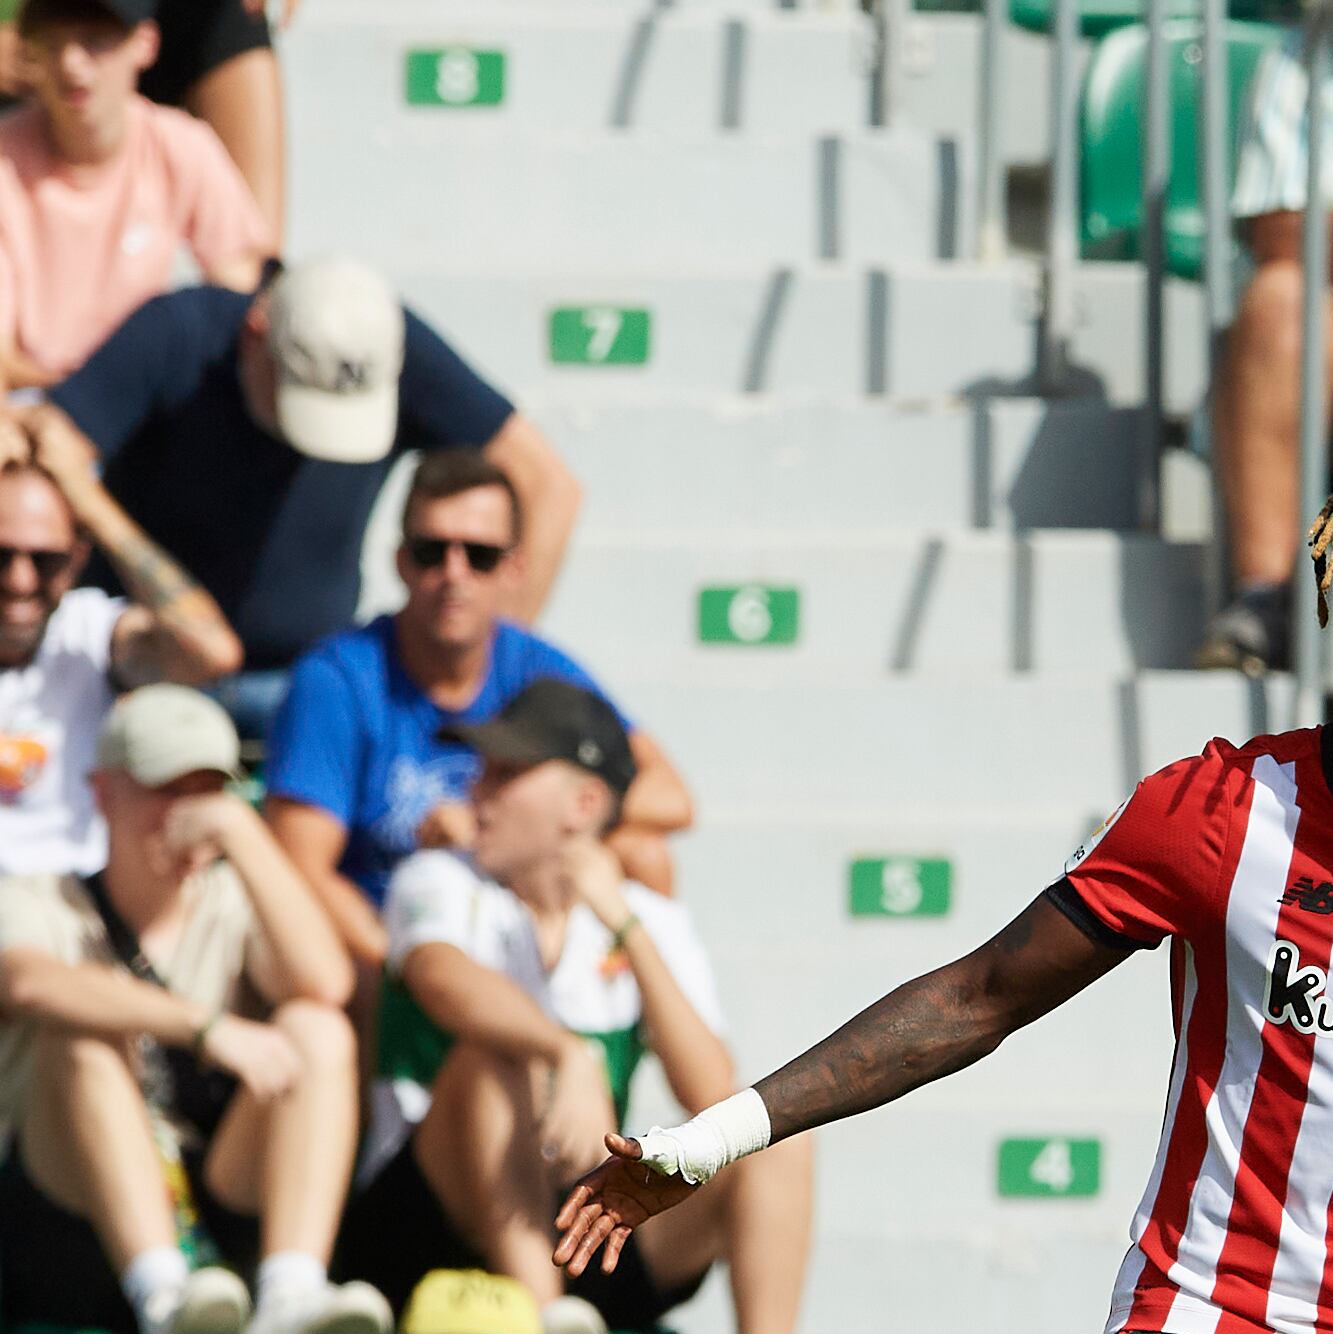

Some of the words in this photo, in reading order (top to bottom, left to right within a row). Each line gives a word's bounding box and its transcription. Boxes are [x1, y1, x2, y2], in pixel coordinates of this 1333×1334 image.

[436, 50, 478, 103] 8
[581, 310, 621, 360] 7
[728, 587, 772, 642] 6
[881, 860, 922, 914] 5
[1029, 1141, 1073, 1192] 4
